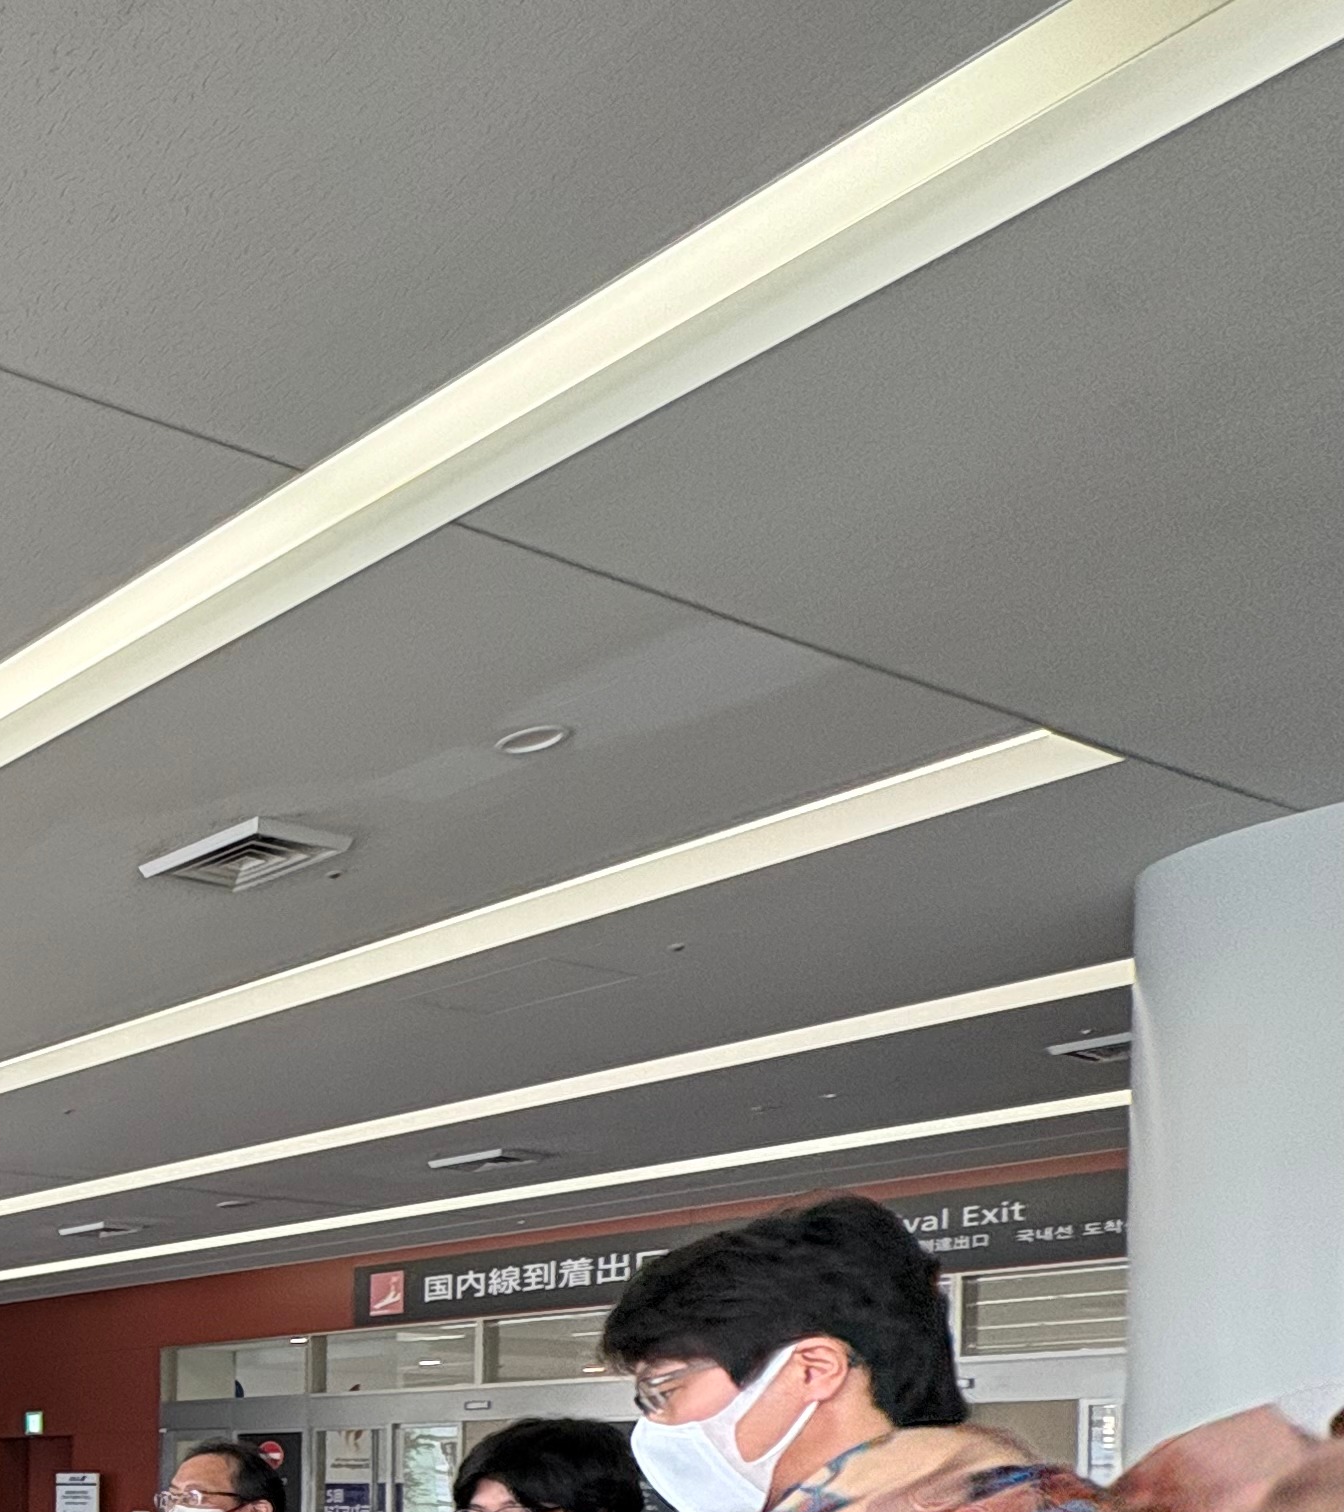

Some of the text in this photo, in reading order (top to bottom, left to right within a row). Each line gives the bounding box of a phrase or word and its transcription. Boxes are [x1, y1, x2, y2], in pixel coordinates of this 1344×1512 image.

[898, 1201, 1027, 1234] val Exit
[1082, 1218, 1128, 1236] 도착
